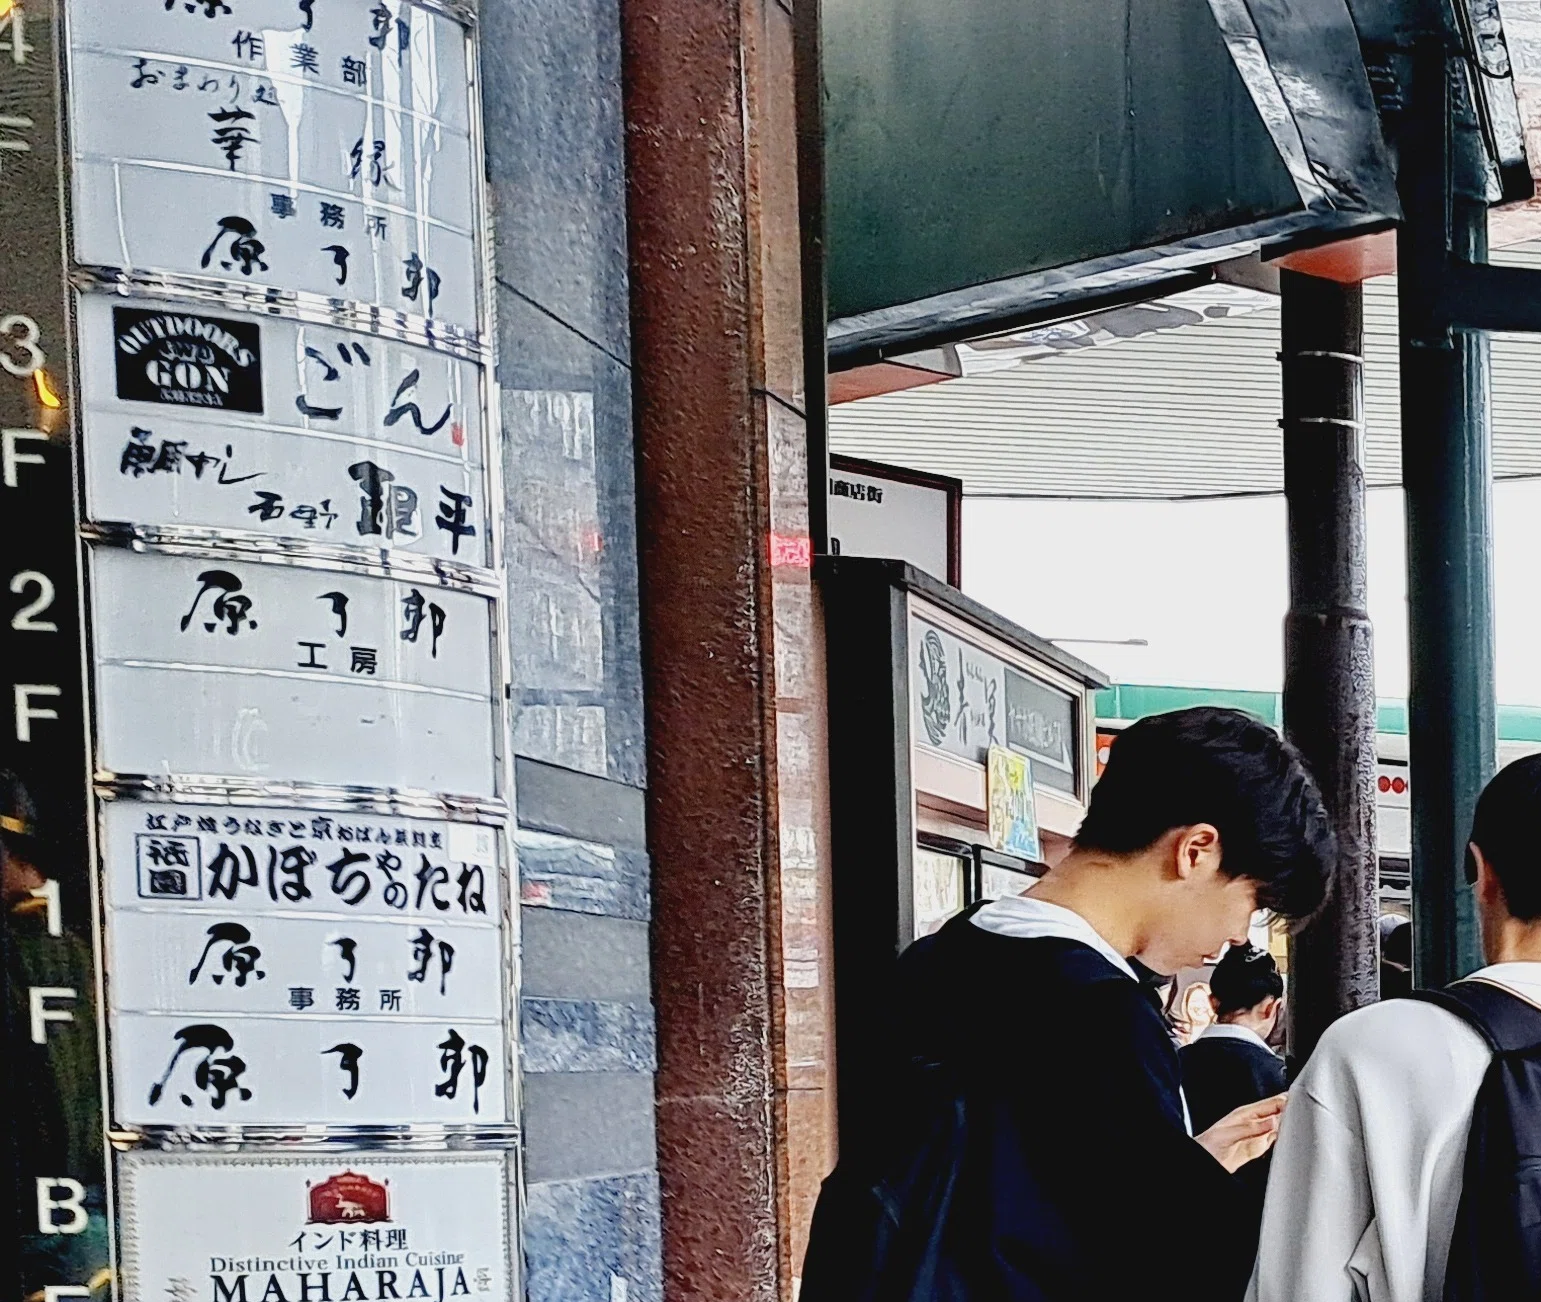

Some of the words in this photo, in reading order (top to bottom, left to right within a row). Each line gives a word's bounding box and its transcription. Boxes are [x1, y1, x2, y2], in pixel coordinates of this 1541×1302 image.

[231, 29, 367, 91] 作業部
[269, 192, 388, 241] 事務所
[145, 360, 232, 394] GON
[10, 570, 59, 633] 2
[298, 641, 378, 675] 工房
[15, 684, 62, 742] F
[208, 844, 487, 915] かぼちゃのたね
[28, 986, 78, 1044] F
[288, 986, 402, 1012] 事務所
[36, 1177, 88, 1235] B
[210, 1257, 328, 1272] Distinctive
[336, 1253, 398, 1270] Indian
[406, 1251, 464, 1266] Cuisine
[289, 1229, 408, 1252] インド料理
